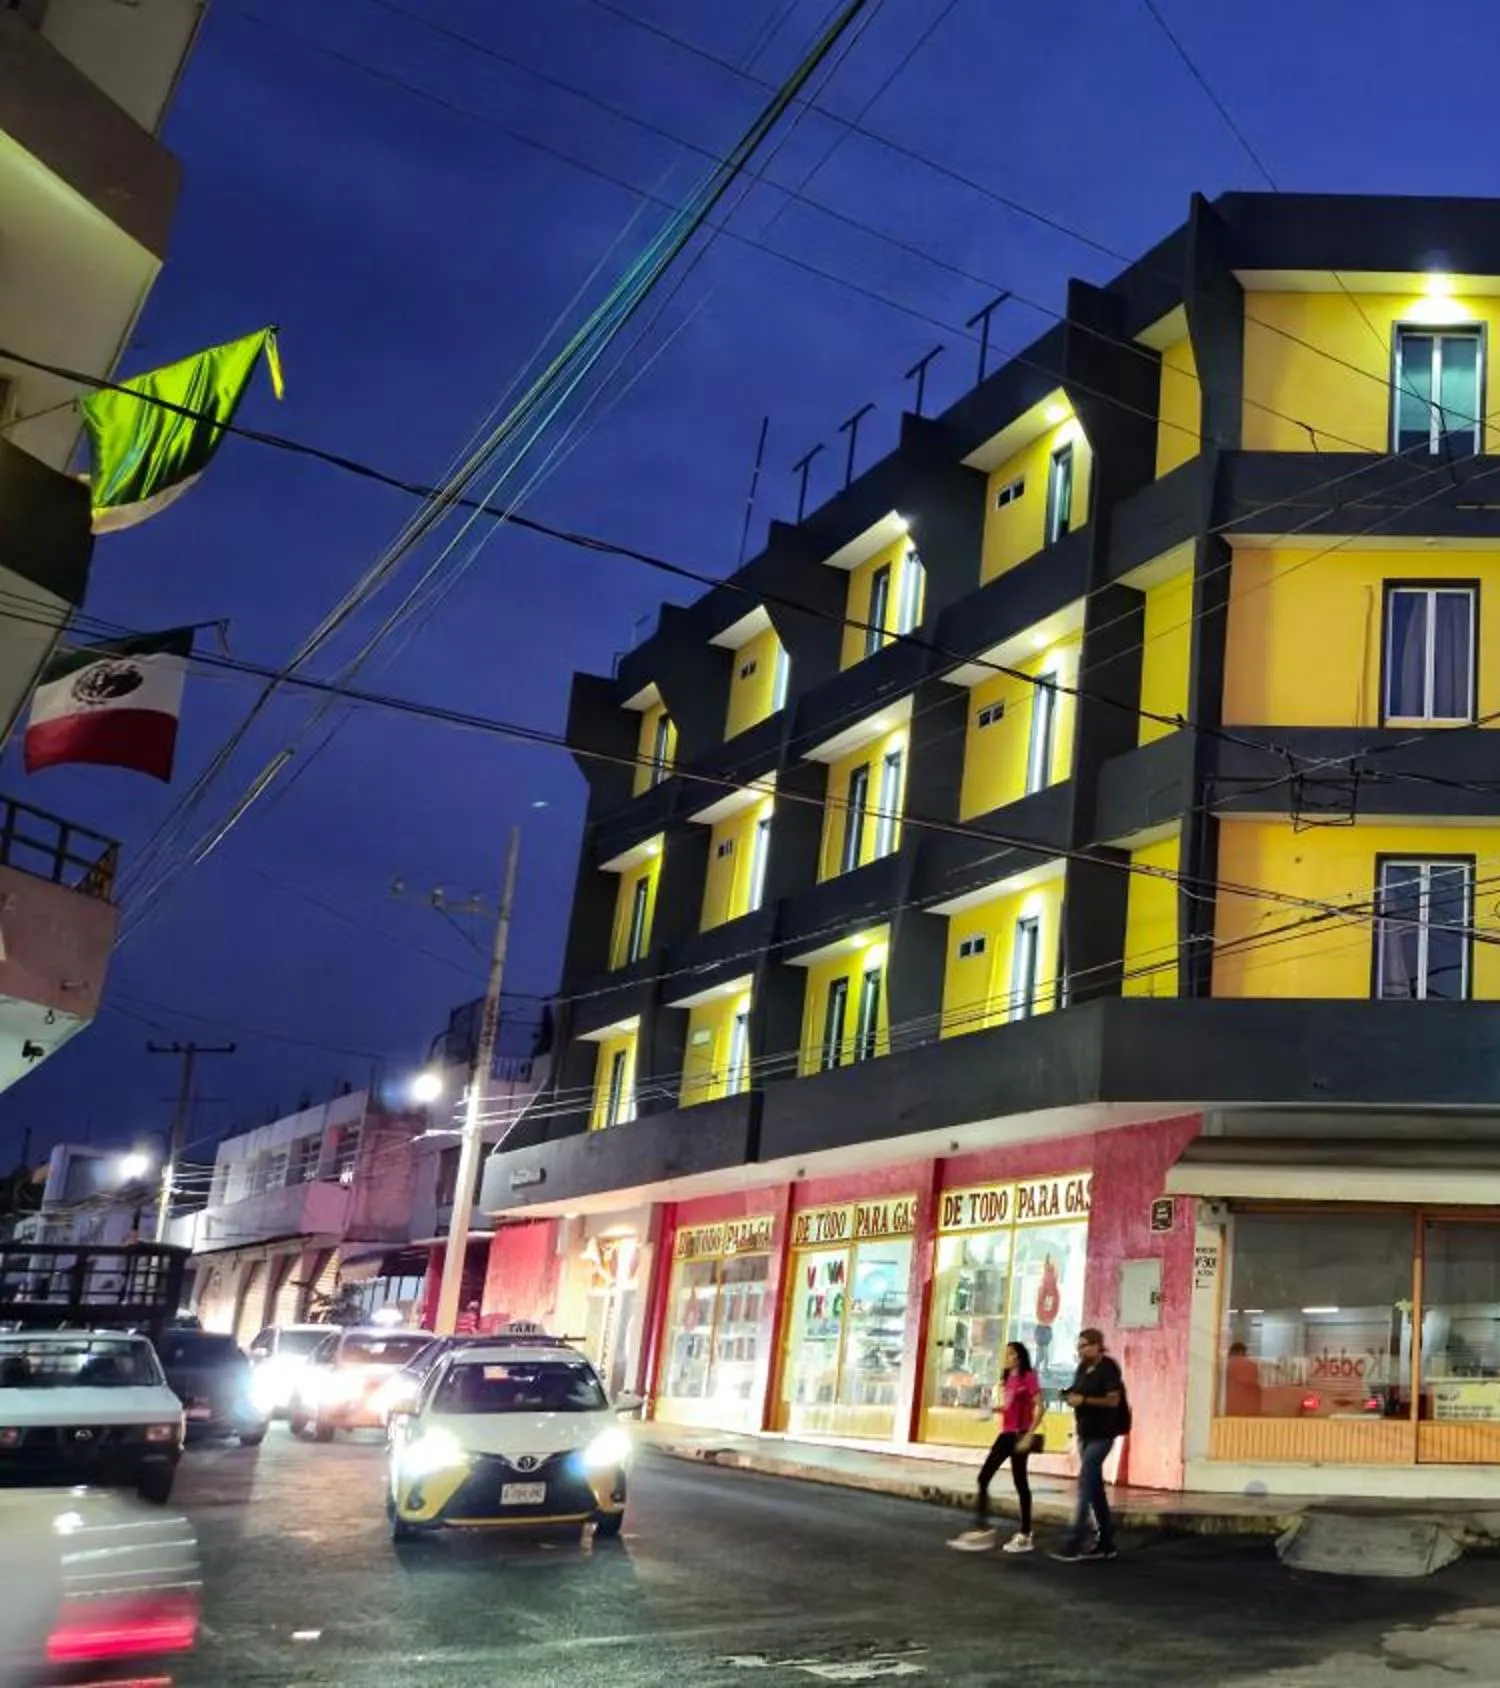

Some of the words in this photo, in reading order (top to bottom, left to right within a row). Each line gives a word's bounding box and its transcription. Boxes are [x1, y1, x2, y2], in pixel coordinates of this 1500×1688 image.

[796, 1215, 811, 1242] DE
[815, 1211, 847, 1241] TODO
[856, 1205, 888, 1235] PARA
[943, 1195, 963, 1226] DE
[970, 1190, 1009, 1224] TODO
[1017, 1184, 1060, 1219] PARA
[508, 1322, 536, 1333] TAXI
